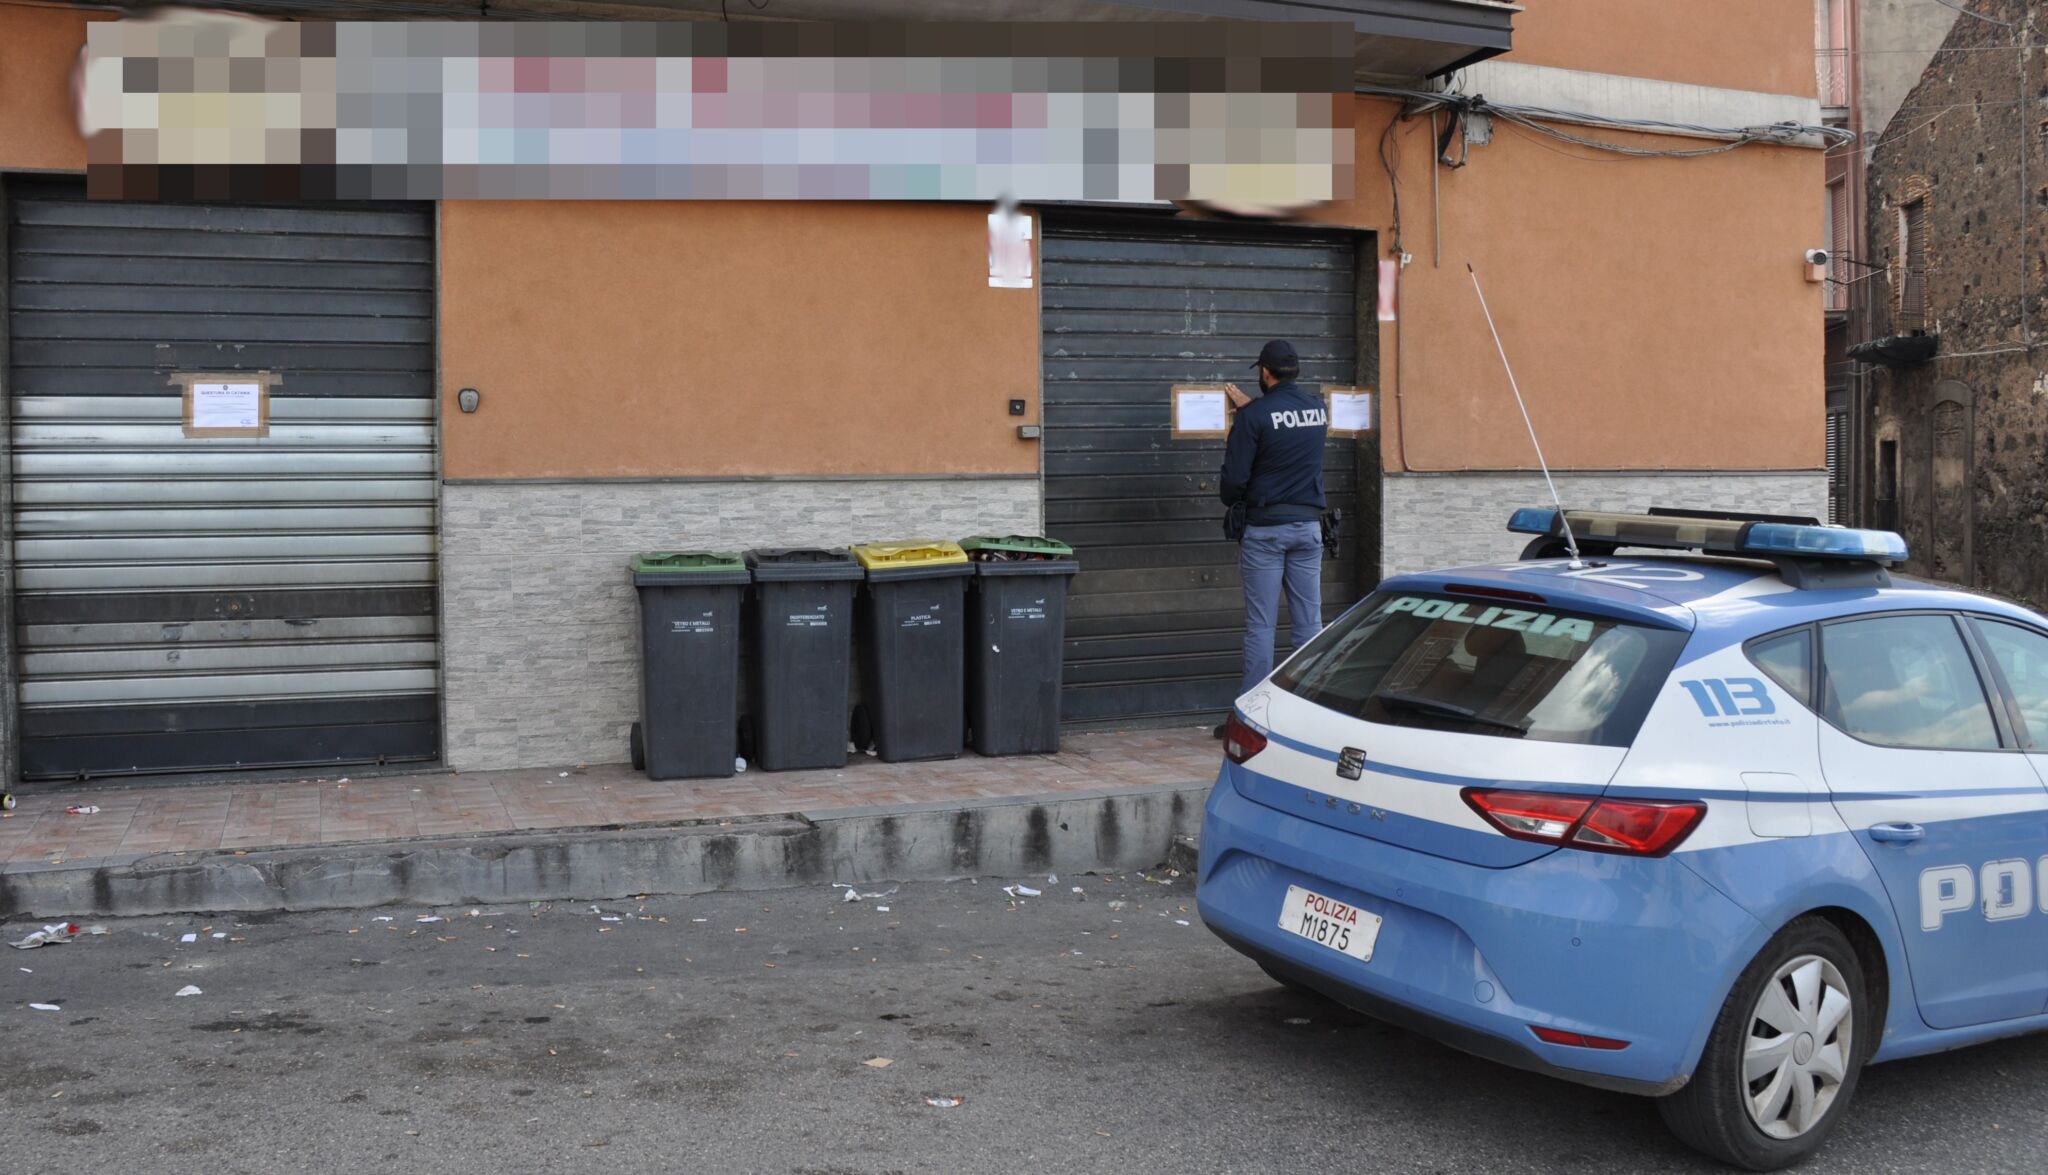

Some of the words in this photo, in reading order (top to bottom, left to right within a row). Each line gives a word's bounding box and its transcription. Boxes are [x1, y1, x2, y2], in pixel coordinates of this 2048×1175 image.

[1271, 408, 1328, 430] POLIZIA
[1383, 596, 1595, 642] POLIZIA
[1679, 677, 1777, 718] 113
[1304, 893, 1358, 926] POLIZIA
[1919, 853, 2048, 932] PO
[1300, 912, 1351, 951] M1875
